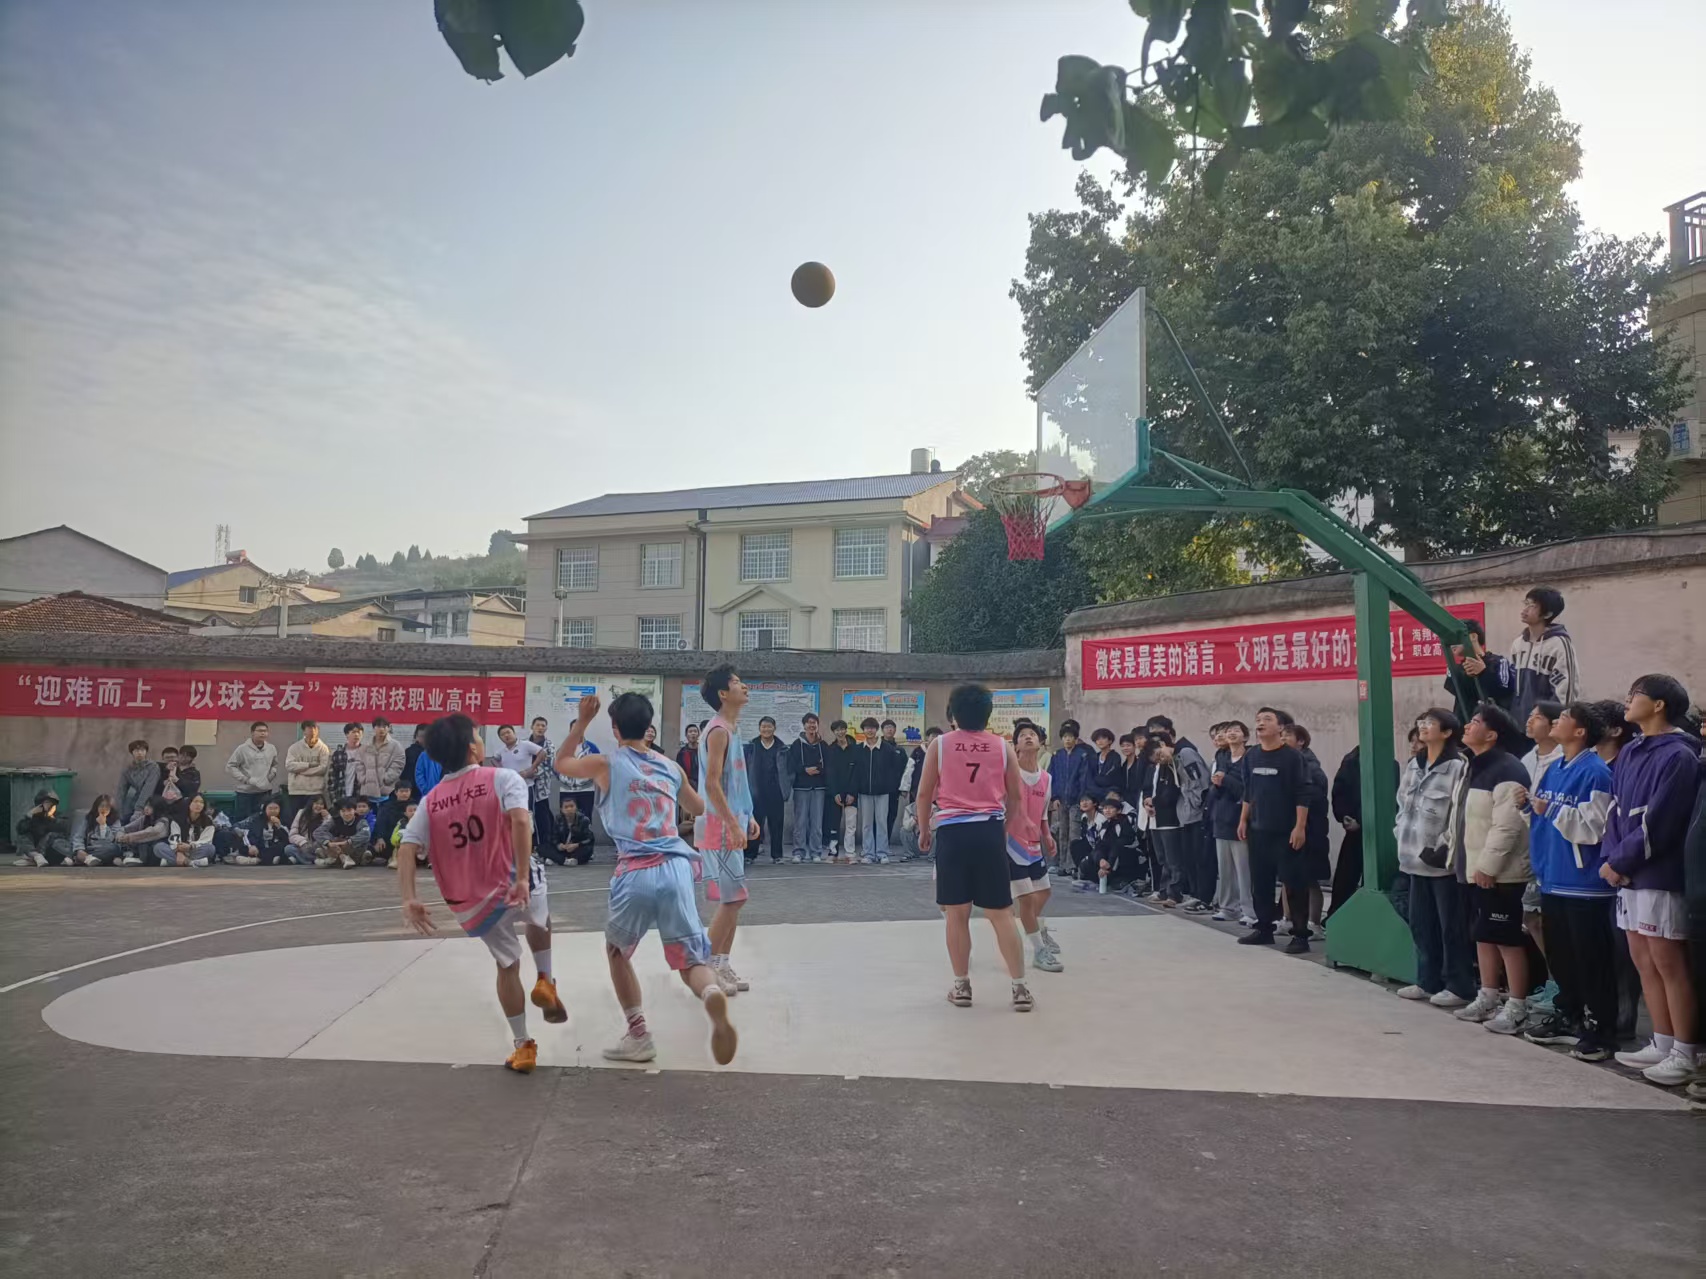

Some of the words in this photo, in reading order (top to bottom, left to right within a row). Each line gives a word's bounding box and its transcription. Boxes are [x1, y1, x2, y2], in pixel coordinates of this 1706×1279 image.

[1095, 626, 1404, 680] 微笑是最美的语言，文明是最好的！
[18, 674, 320, 711] “迎难而上，以球会友”
[955, 743, 968, 752] ZL
[970, 743, 990, 752] 大王
[965, 762, 981, 783] 7
[464, 783, 488, 802] 大王
[448, 814, 485, 849] 30
